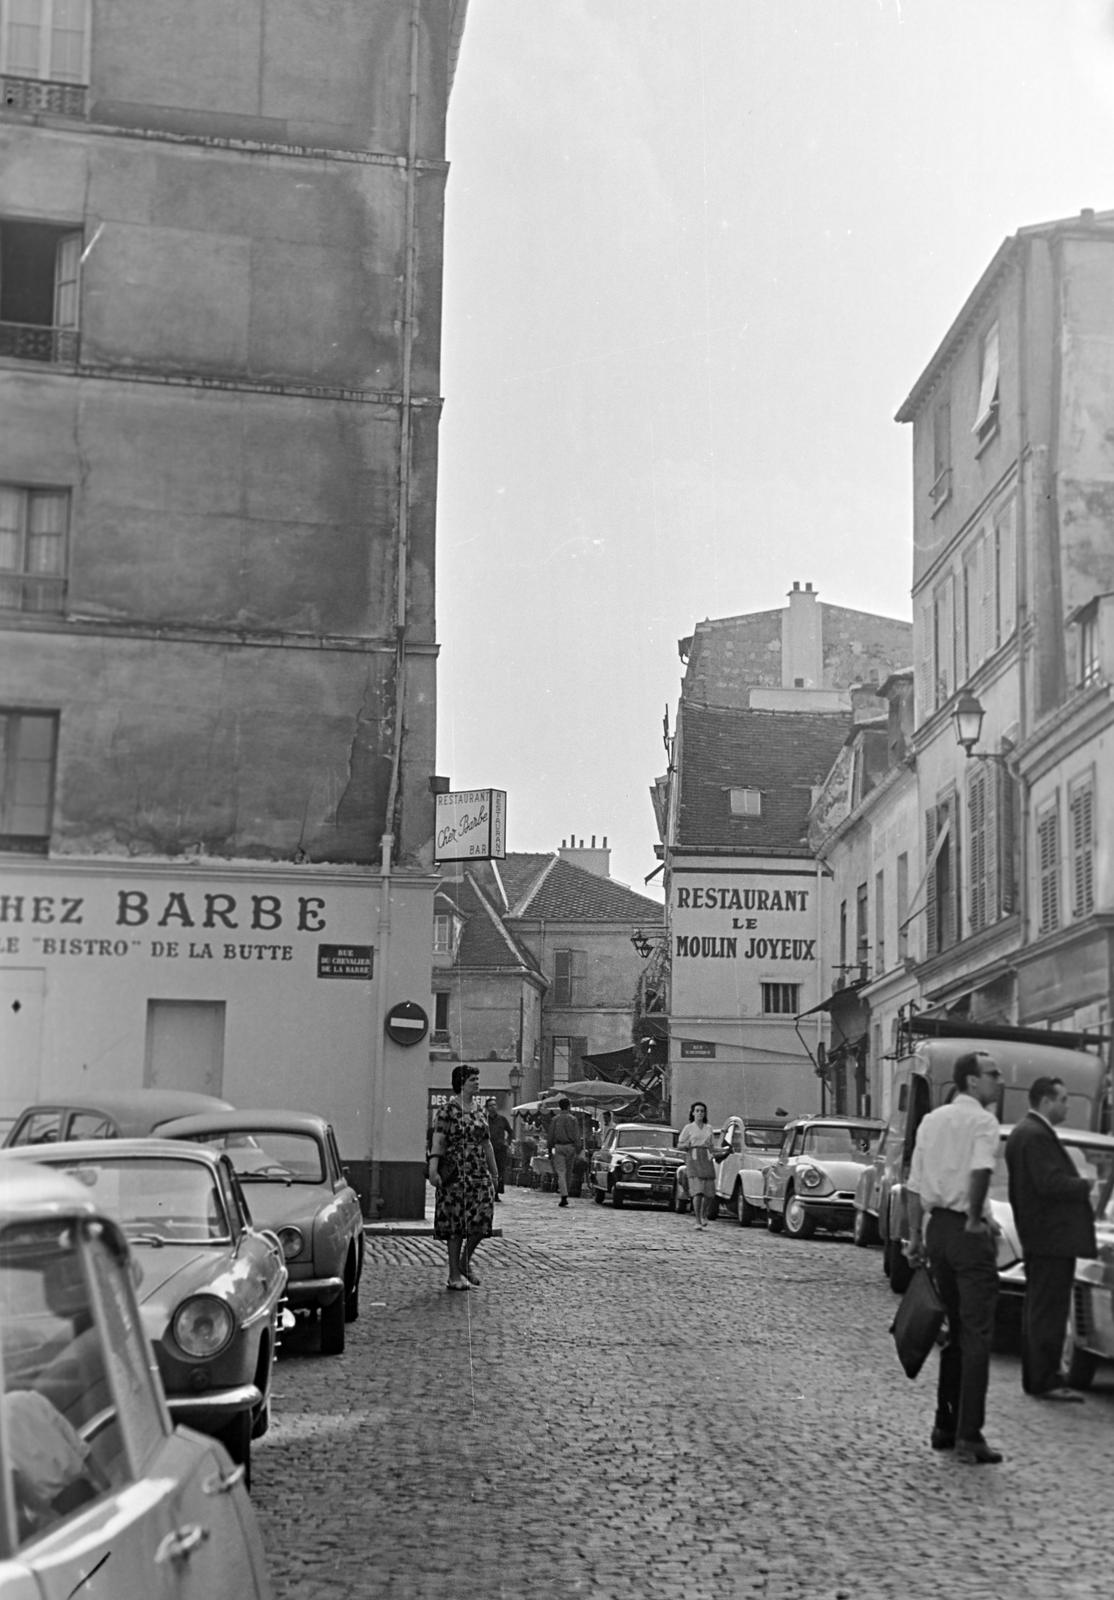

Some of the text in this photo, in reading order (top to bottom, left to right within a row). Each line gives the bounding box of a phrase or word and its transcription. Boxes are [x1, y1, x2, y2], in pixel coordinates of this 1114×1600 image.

[438, 792, 489, 805] RESTAURANT
[437, 805, 488, 848] Chez Barbe
[469, 844, 487, 855] BAR
[115, 890, 327, 932] BARBE
[677, 887, 809, 911] RESTAURANT
[732, 918, 758, 929] LE
[32, 938, 142, 957] "BISTRO"
[151, 941, 179, 959] DE
[189, 943, 214, 960] LA
[223, 944, 293, 962] BUTTE
[676, 936, 816, 960] MOULIN JOYEUX
[431, 1094, 447, 1106] DES
